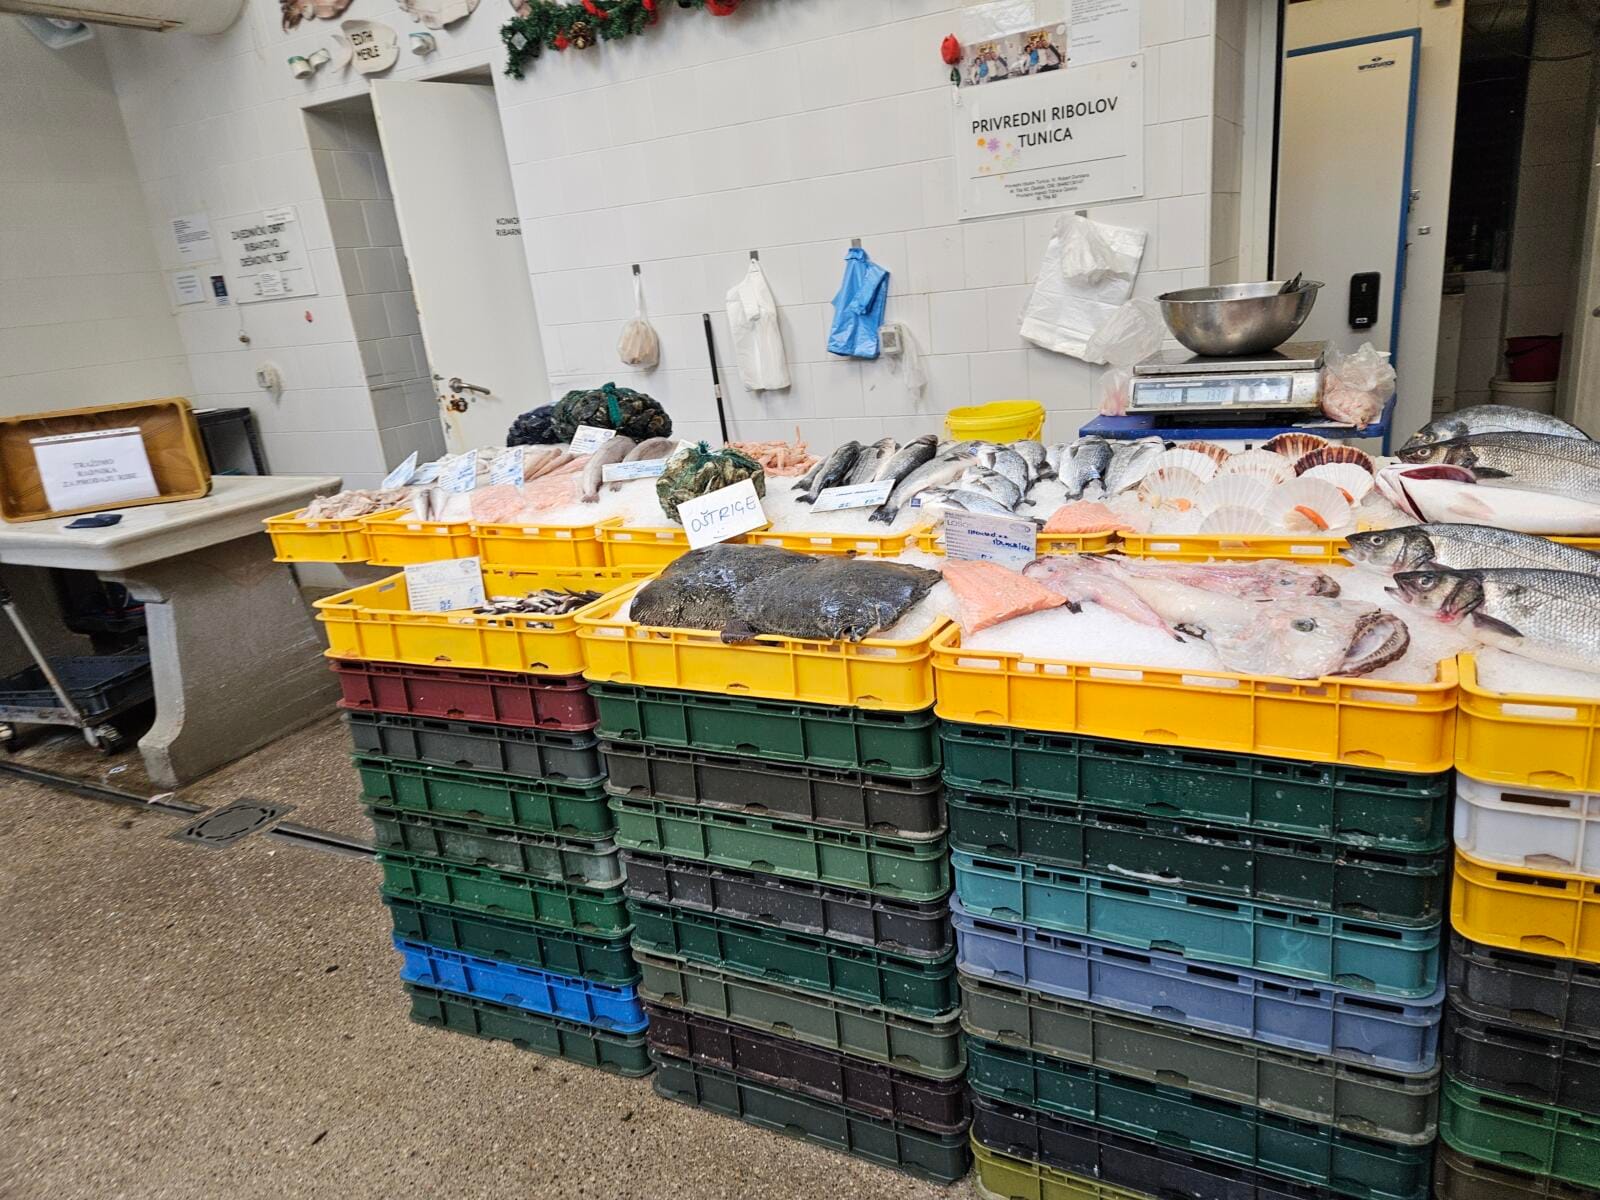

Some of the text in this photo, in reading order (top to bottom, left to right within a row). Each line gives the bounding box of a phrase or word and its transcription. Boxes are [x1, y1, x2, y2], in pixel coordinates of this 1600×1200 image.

[972, 96, 1118, 134] PRIVREDNI RIBOLOV
[1018, 127, 1073, 148] TUNICA
[691, 495, 757, 533] OŠTRIGE
